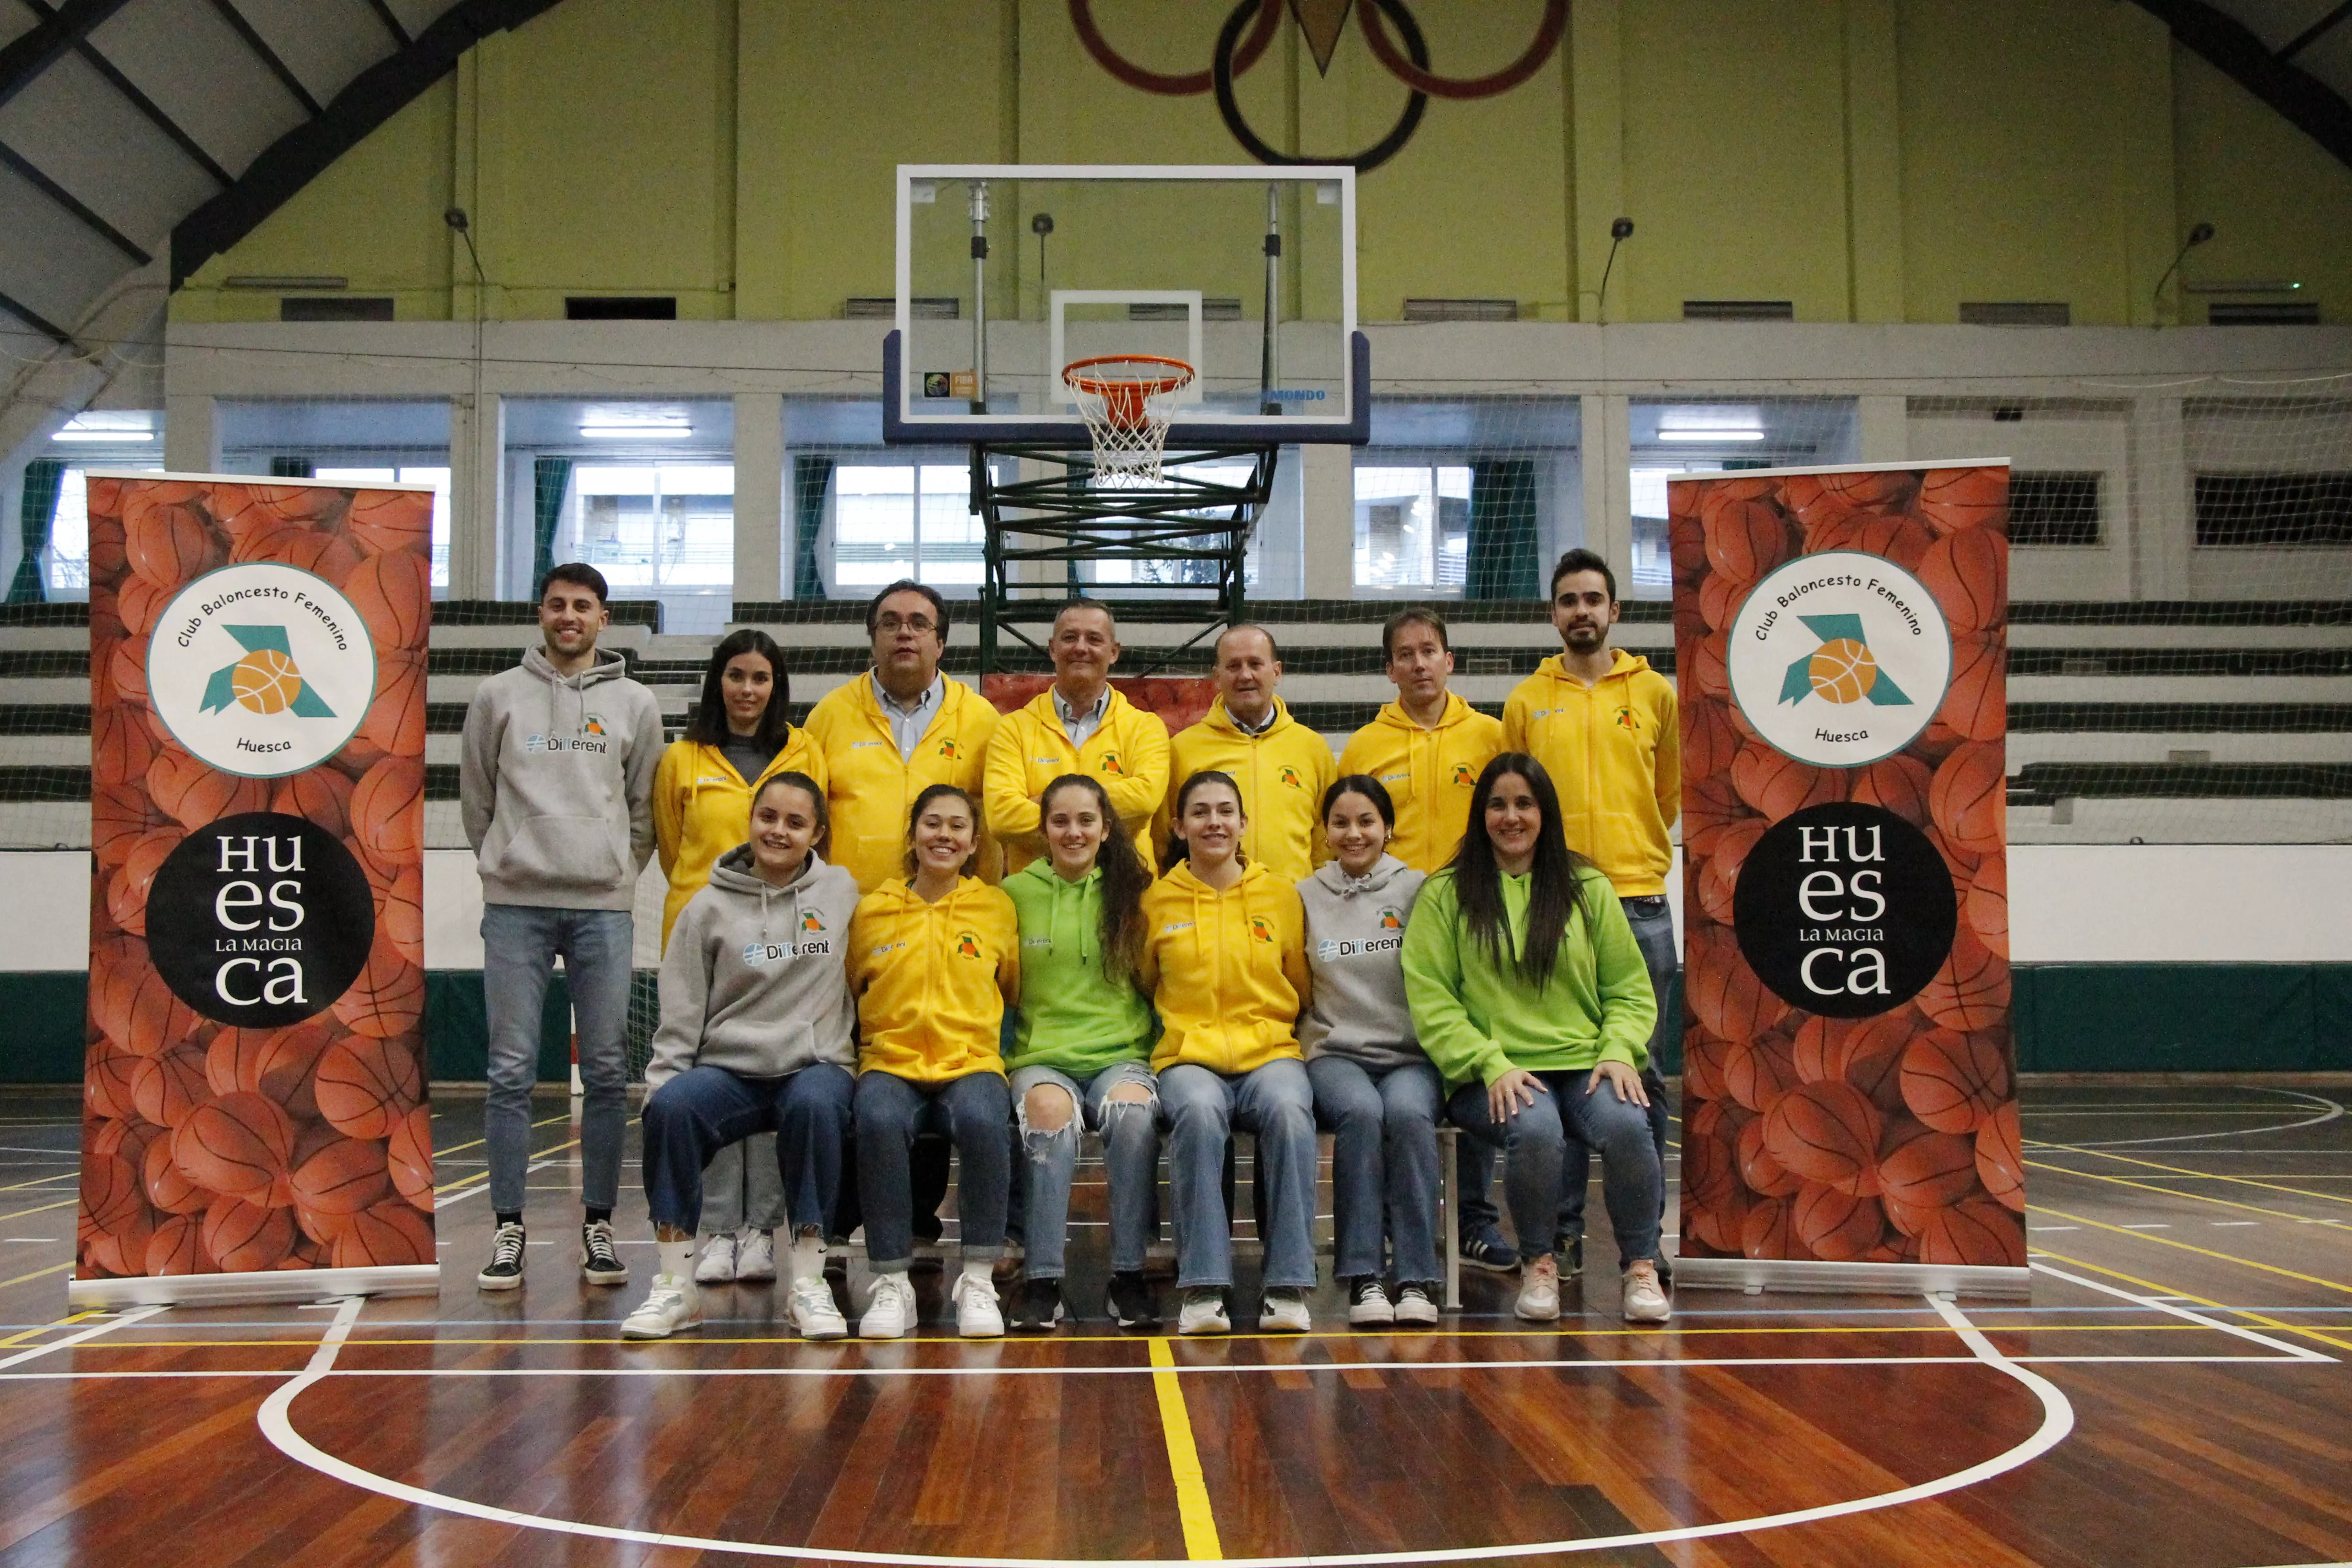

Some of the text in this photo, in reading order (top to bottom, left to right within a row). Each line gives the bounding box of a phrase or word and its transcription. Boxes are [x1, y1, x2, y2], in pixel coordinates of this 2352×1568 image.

[1266, 390, 1325, 400] MONDO
[178, 586, 347, 651] Club Baloncesto Femenino
[1756, 574, 1921, 640] Club Baloncesto Femenino
[236, 737, 291, 753] Huesca
[548, 737, 607, 754] Different
[1815, 728, 1869, 742] Huesca
[216, 835, 306, 872] Hu
[1798, 825, 1886, 862] Hu
[215, 880, 305, 932] es
[1799, 870, 1886, 921] es
[1173, 922, 1195, 930] Dierent
[215, 957, 308, 1005] ca
[1800, 947, 1891, 995] ca
